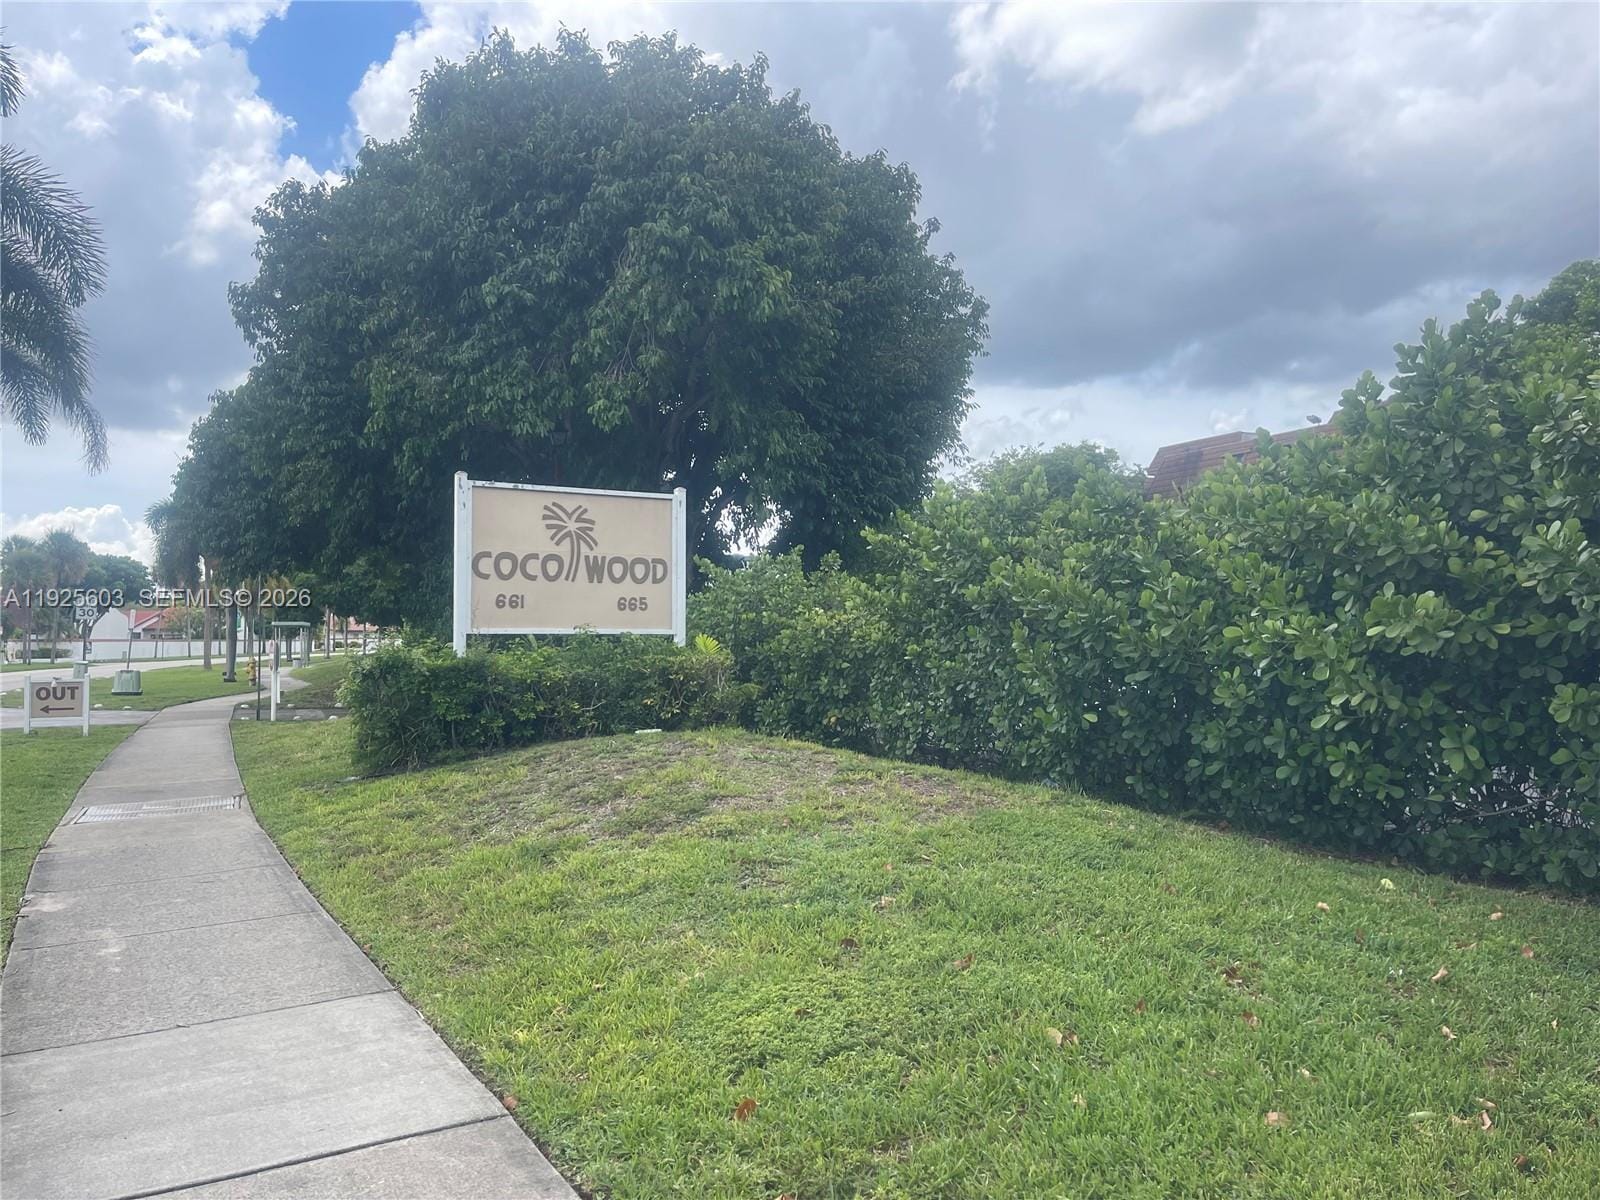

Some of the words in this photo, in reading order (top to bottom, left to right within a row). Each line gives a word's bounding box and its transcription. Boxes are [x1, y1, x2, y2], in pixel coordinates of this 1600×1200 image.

[472, 551, 565, 582] COCO
[584, 555, 668, 584] WOOD
[495, 593, 525, 609] 661
[617, 597, 648, 612] 665
[79, 608, 95, 617] 30
[35, 686, 79, 700] OUT
